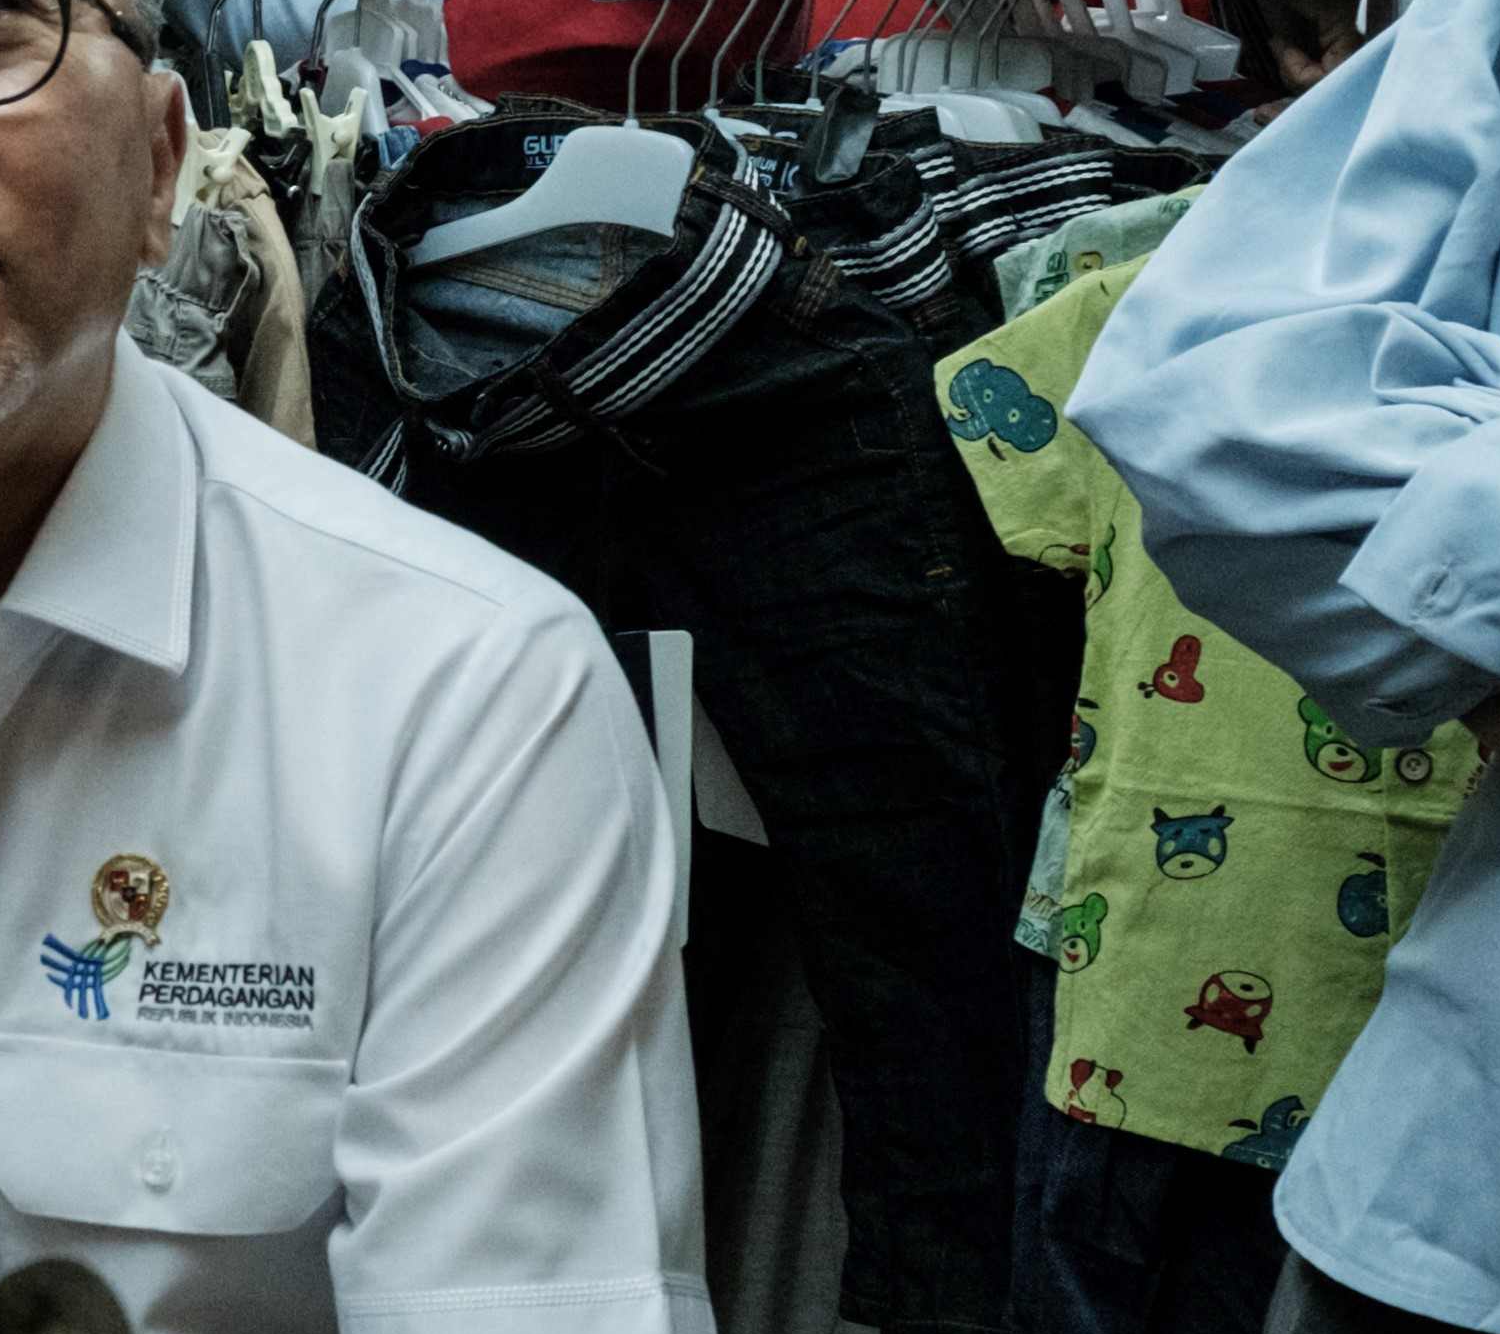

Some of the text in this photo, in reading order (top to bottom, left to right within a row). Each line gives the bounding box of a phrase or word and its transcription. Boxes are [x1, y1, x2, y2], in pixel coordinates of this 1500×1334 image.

[143, 961, 315, 987] KEMENTERIAN
[138, 983, 315, 1011] PERDAGANGAN
[136, 1005, 314, 1031] REPUBLIK INDONESIA
